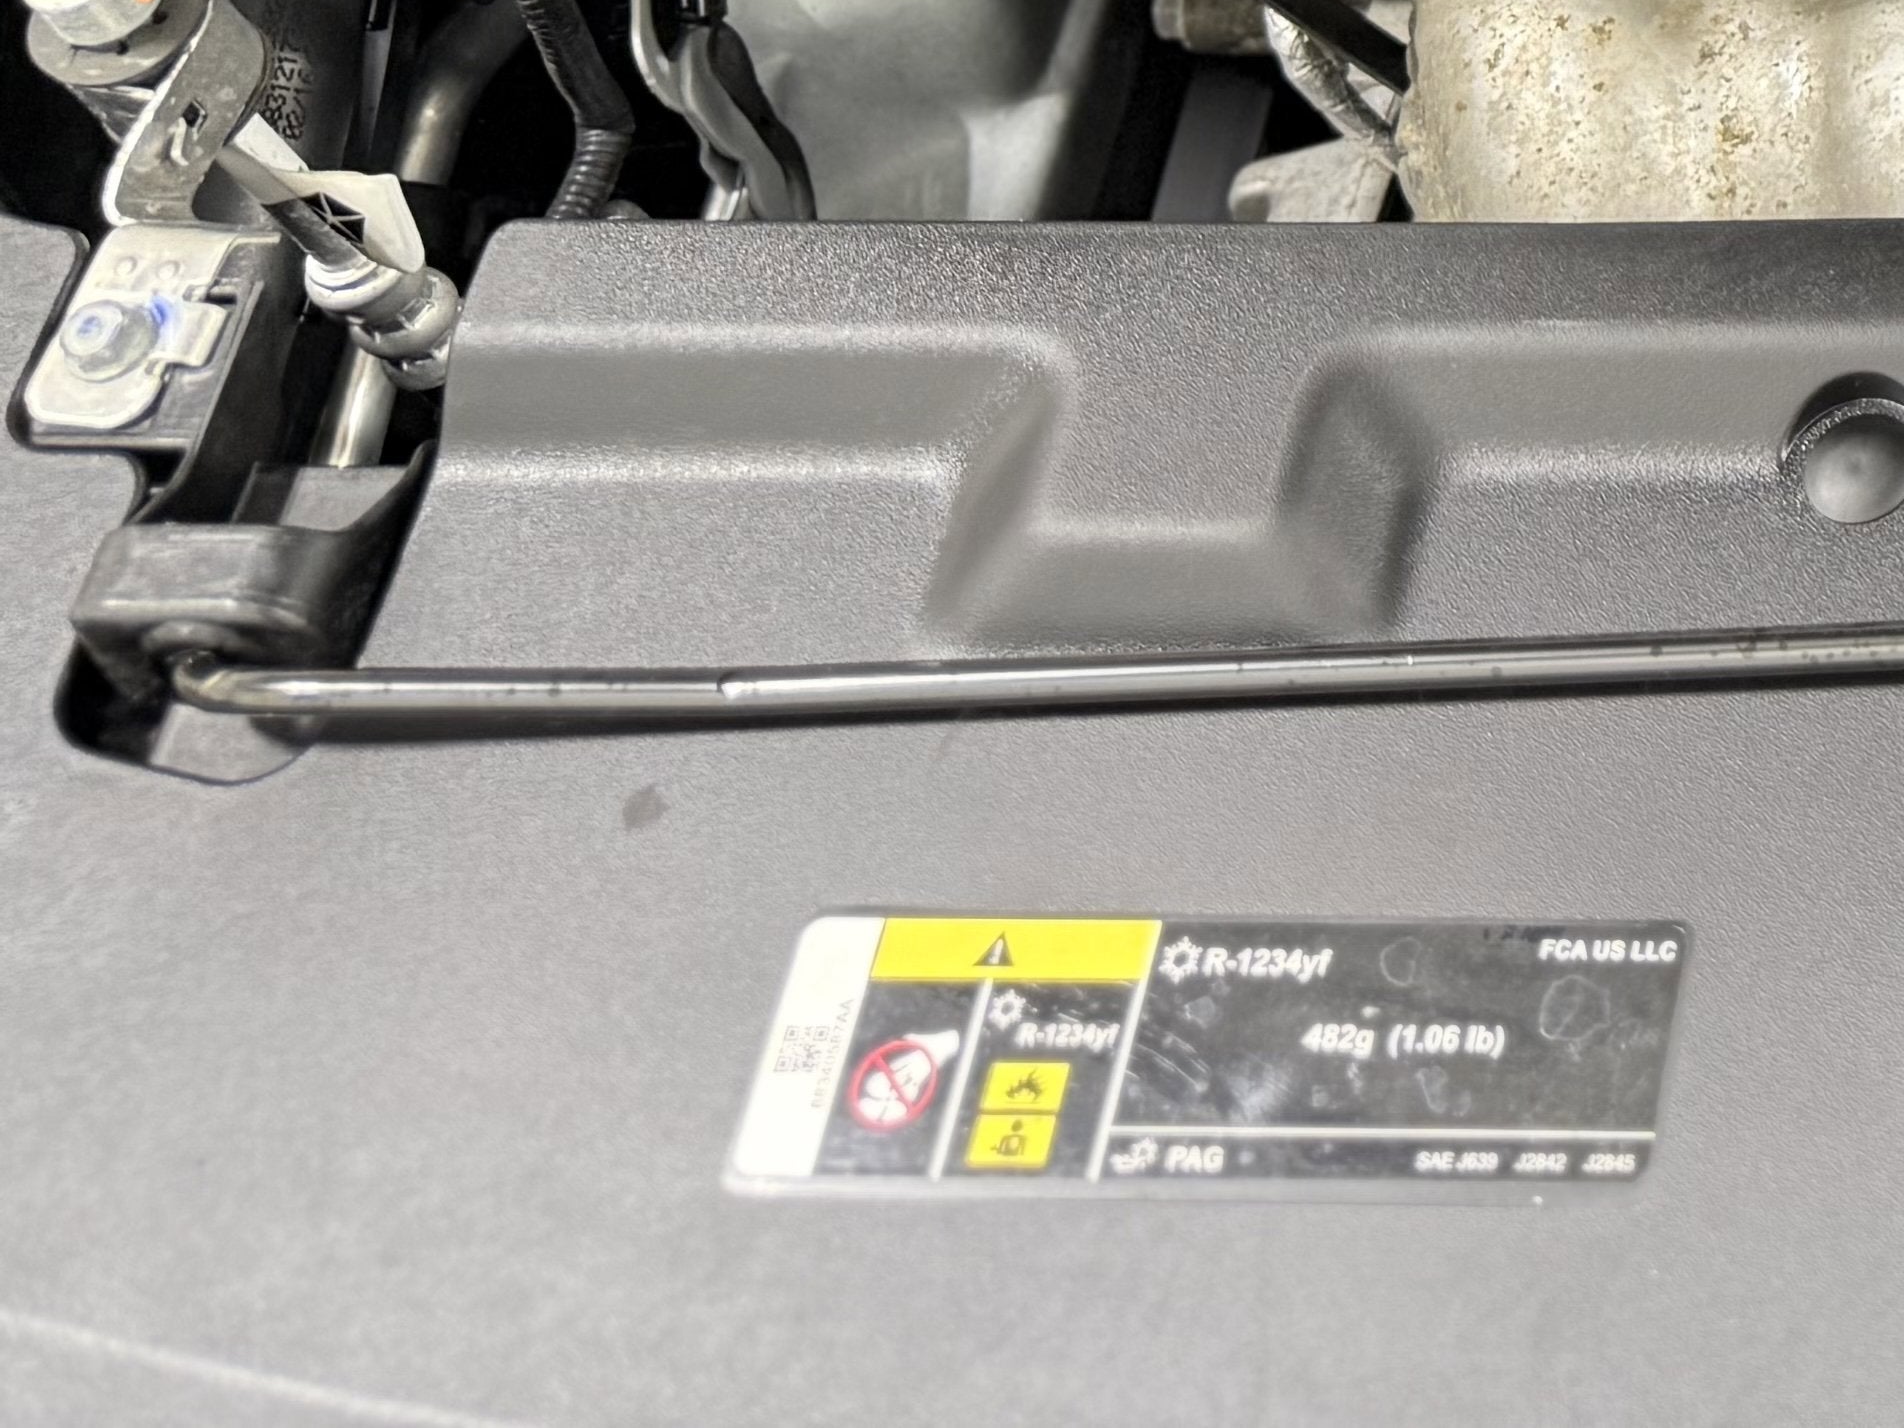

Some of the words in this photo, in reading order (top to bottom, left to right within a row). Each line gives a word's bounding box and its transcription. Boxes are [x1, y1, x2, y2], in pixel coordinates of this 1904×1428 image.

[1202, 948, 1333, 979] R-1234yf
[1540, 938, 1591, 961] FCA
[1593, 939, 1625, 961] US
[1629, 940, 1677, 963] LLC
[1016, 1022, 1119, 1048] R-1234yf
[1301, 1024, 1376, 1056] 482g
[1388, 1024, 1459, 1059] (1.06
[1463, 1024, 1506, 1059] lb)
[1164, 1147, 1224, 1173] PAG
[1415, 1152, 1454, 1172] SAE
